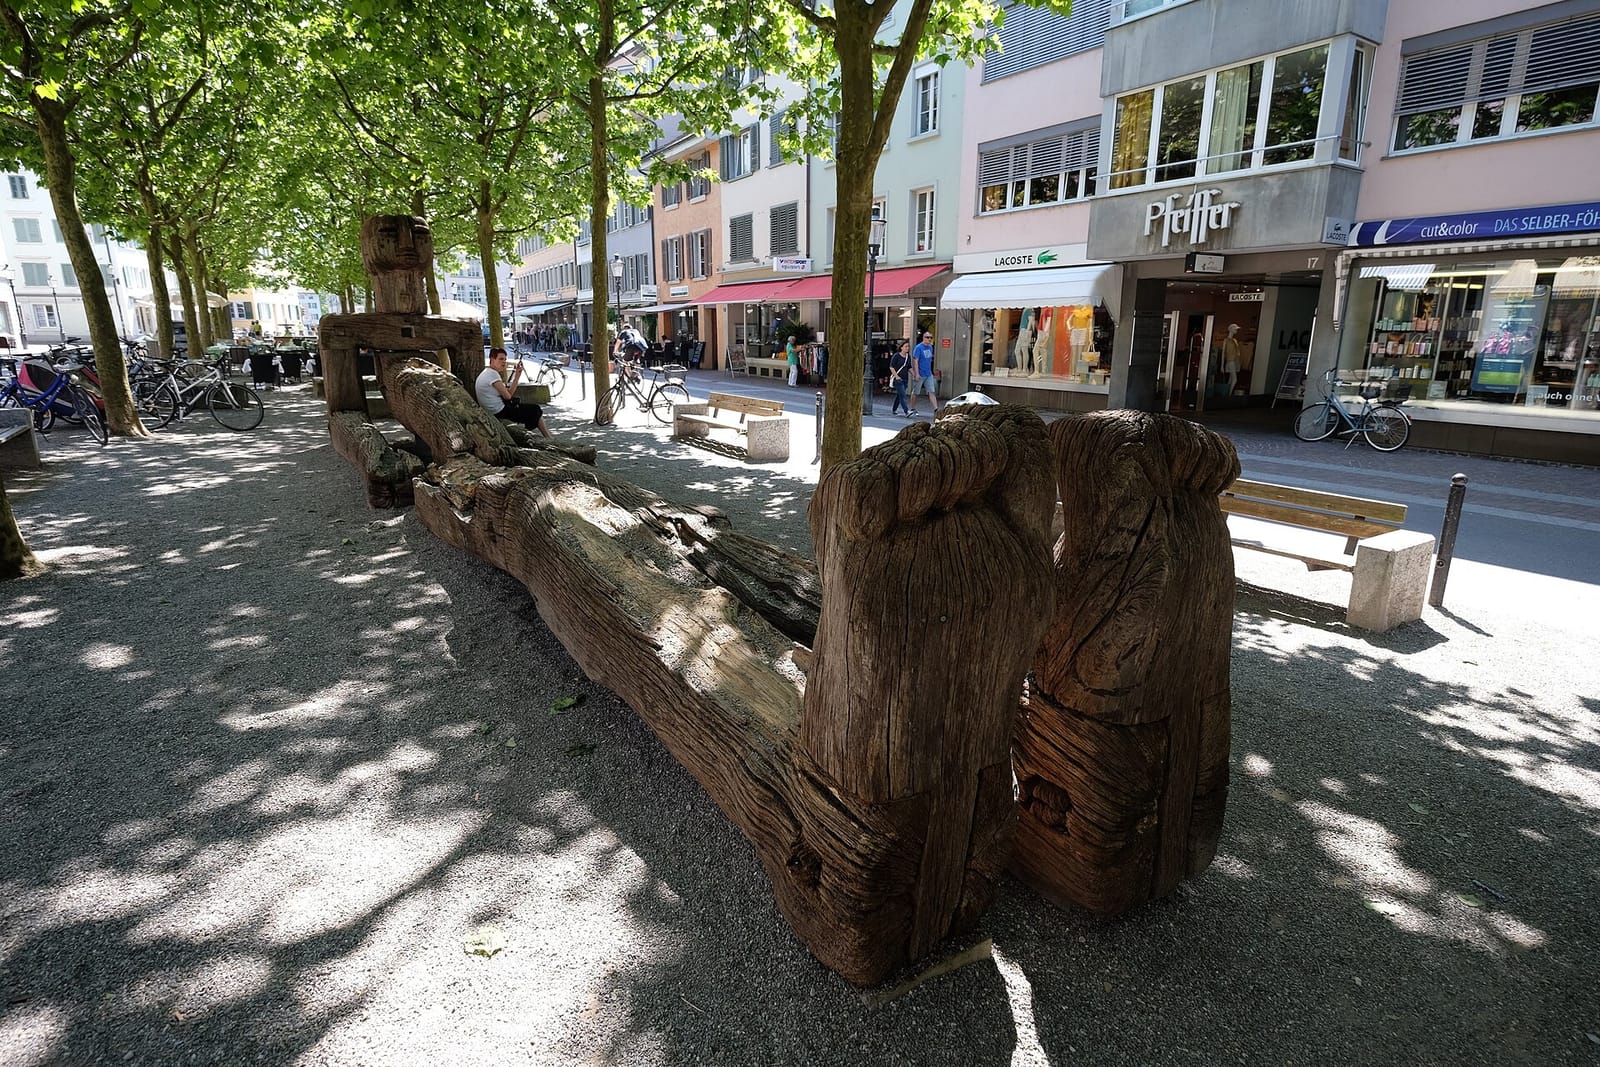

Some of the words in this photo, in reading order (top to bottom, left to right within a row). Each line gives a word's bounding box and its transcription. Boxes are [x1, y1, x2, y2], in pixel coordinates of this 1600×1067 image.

[1144, 188, 1241, 247] Pfeiffer
[1421, 222, 1479, 238] cut&color
[1494, 217, 1519, 233] DAS
[1326, 232, 1347, 241] LACOSTE
[994, 255, 1033, 266] LACOSTE
[1307, 257, 1319, 269] 17
[1565, 393, 1593, 401] ohne
